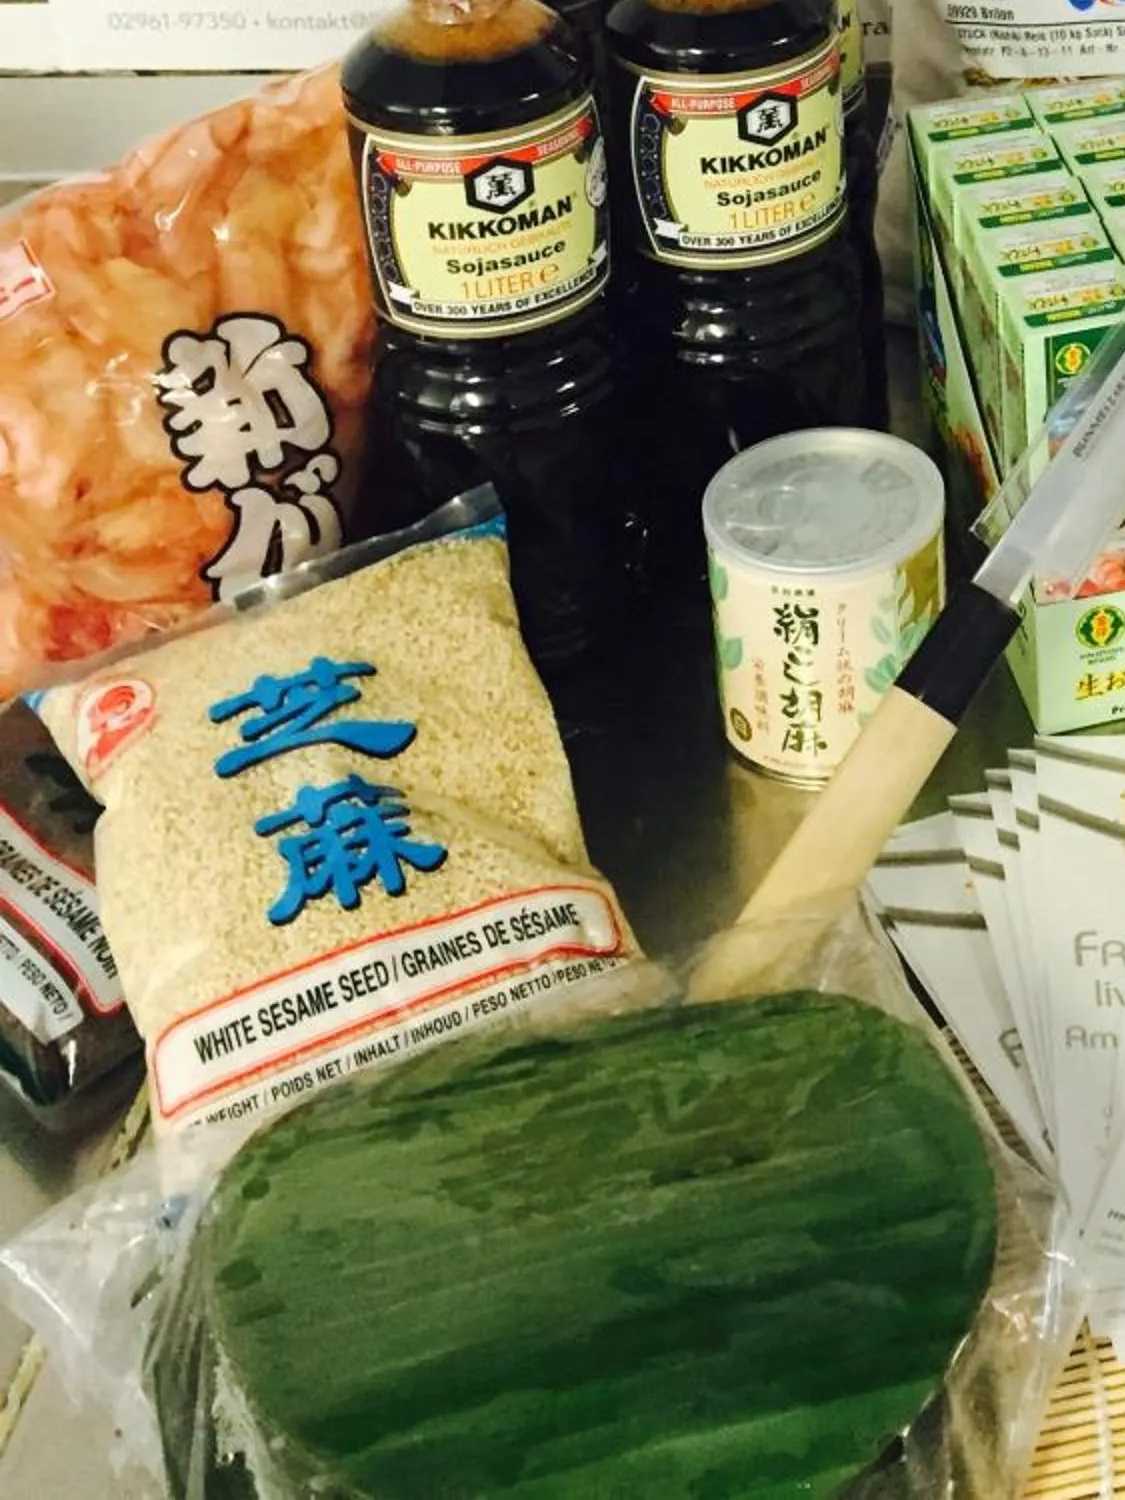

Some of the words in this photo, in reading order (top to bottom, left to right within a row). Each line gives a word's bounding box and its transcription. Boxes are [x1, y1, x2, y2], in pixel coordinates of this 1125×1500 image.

[699, 128, 829, 175] KIKKOMAN
[717, 169, 822, 208] Sojasauce
[427, 195, 573, 241] KIKKOMAN
[682, 234, 711, 247] OVER
[716, 235, 735, 247] 300
[738, 230, 776, 246] YEARS
[777, 225, 792, 238] OF
[742, 200, 797, 230] LITER
[446, 239, 567, 277] Sojasauce
[413, 301, 444, 315] OVER
[446, 304, 468, 316] 300
[471, 302, 512, 316] YEARS
[515, 297, 531, 310] OF
[473, 271, 534, 300] LITER
[208, 655, 448, 927] 芝麻
[48, 883, 102, 944] SÉSAME
[193, 1014, 257, 1065] WHITE
[260, 981, 337, 1037] SESAME
[338, 960, 390, 1002] SEED
[400, 930, 484, 978] GRAINES
[485, 920, 508, 949] DE
[510, 902, 580, 943] SÉSAME
[271, 1073, 314, 1103] POIDS
[316, 1059, 343, 1088] NET
[353, 1035, 402, 1067] INHALT
[410, 1011, 464, 1046] INHOUD
[471, 991, 508, 1019] PESO
[510, 975, 551, 1006] NETTO
